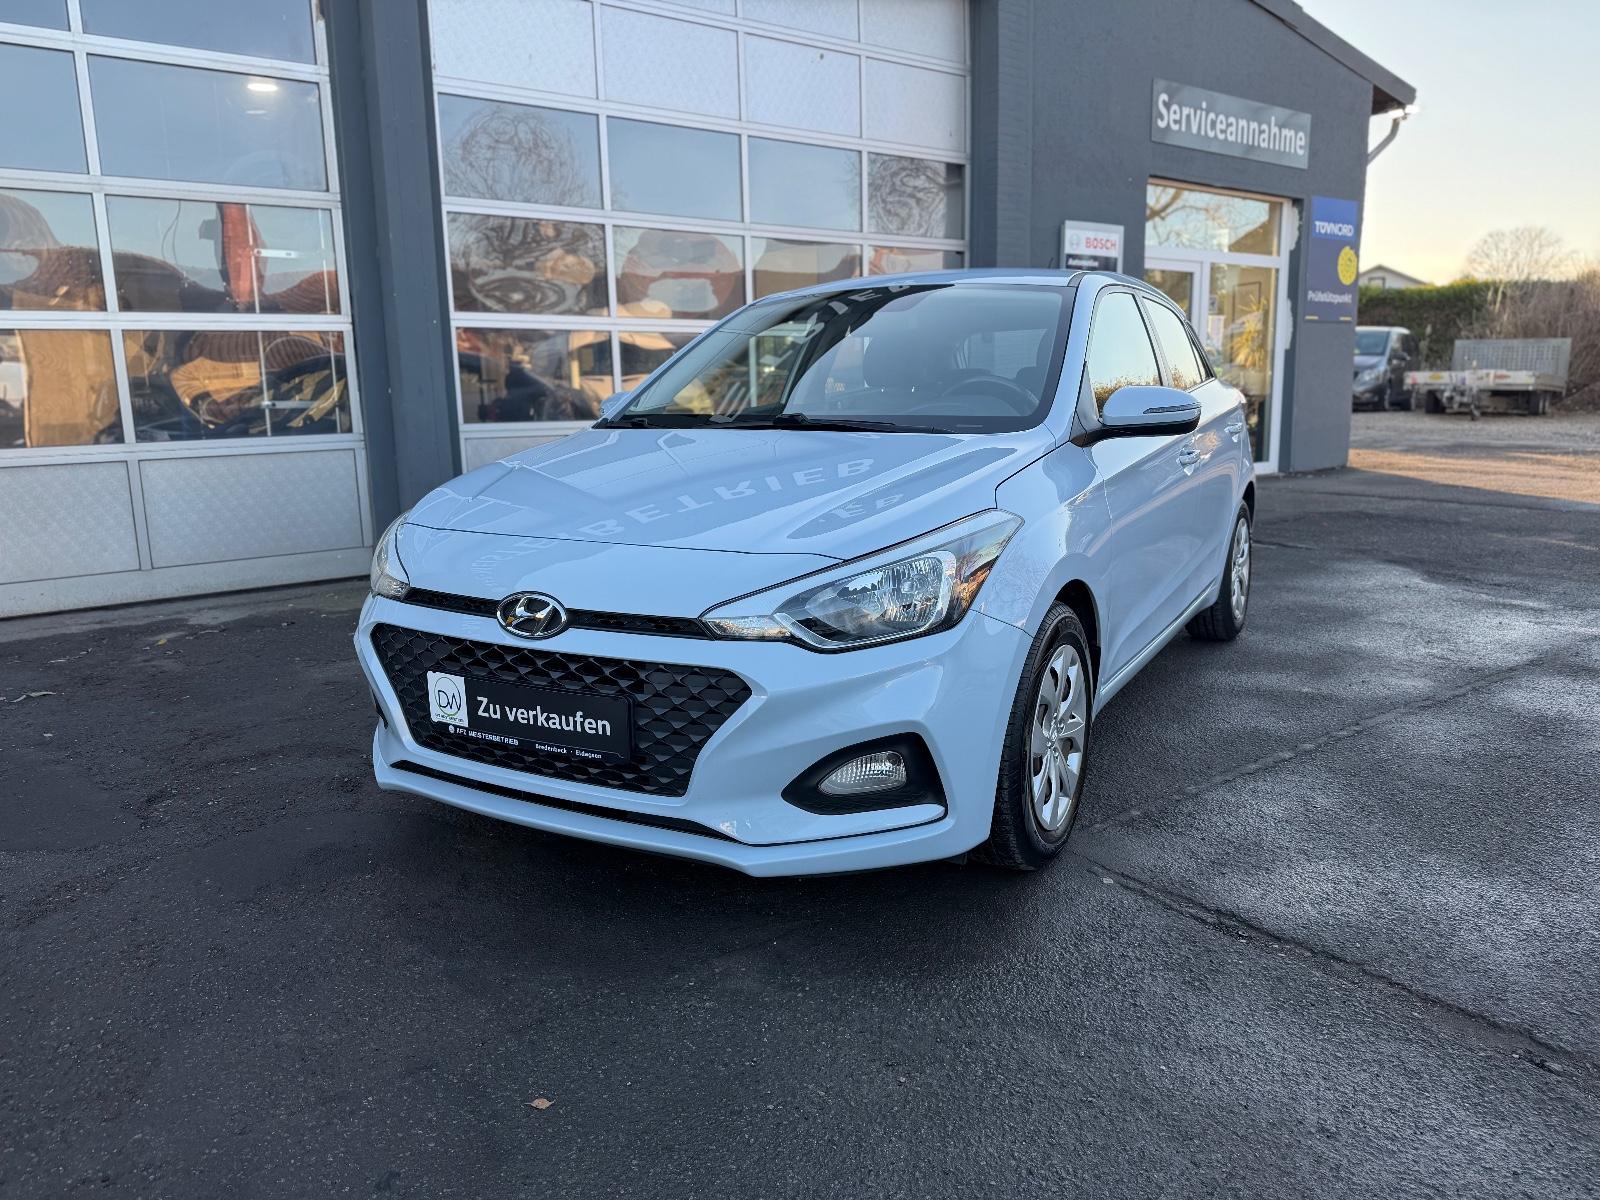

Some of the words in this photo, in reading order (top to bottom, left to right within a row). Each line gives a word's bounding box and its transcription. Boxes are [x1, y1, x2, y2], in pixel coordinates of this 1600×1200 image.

[1156, 92, 1306, 156] Serviceannahme
[1085, 236, 1117, 251] BOSCH
[476, 696, 501, 720] Zu
[505, 705, 611, 736] verkaufen
